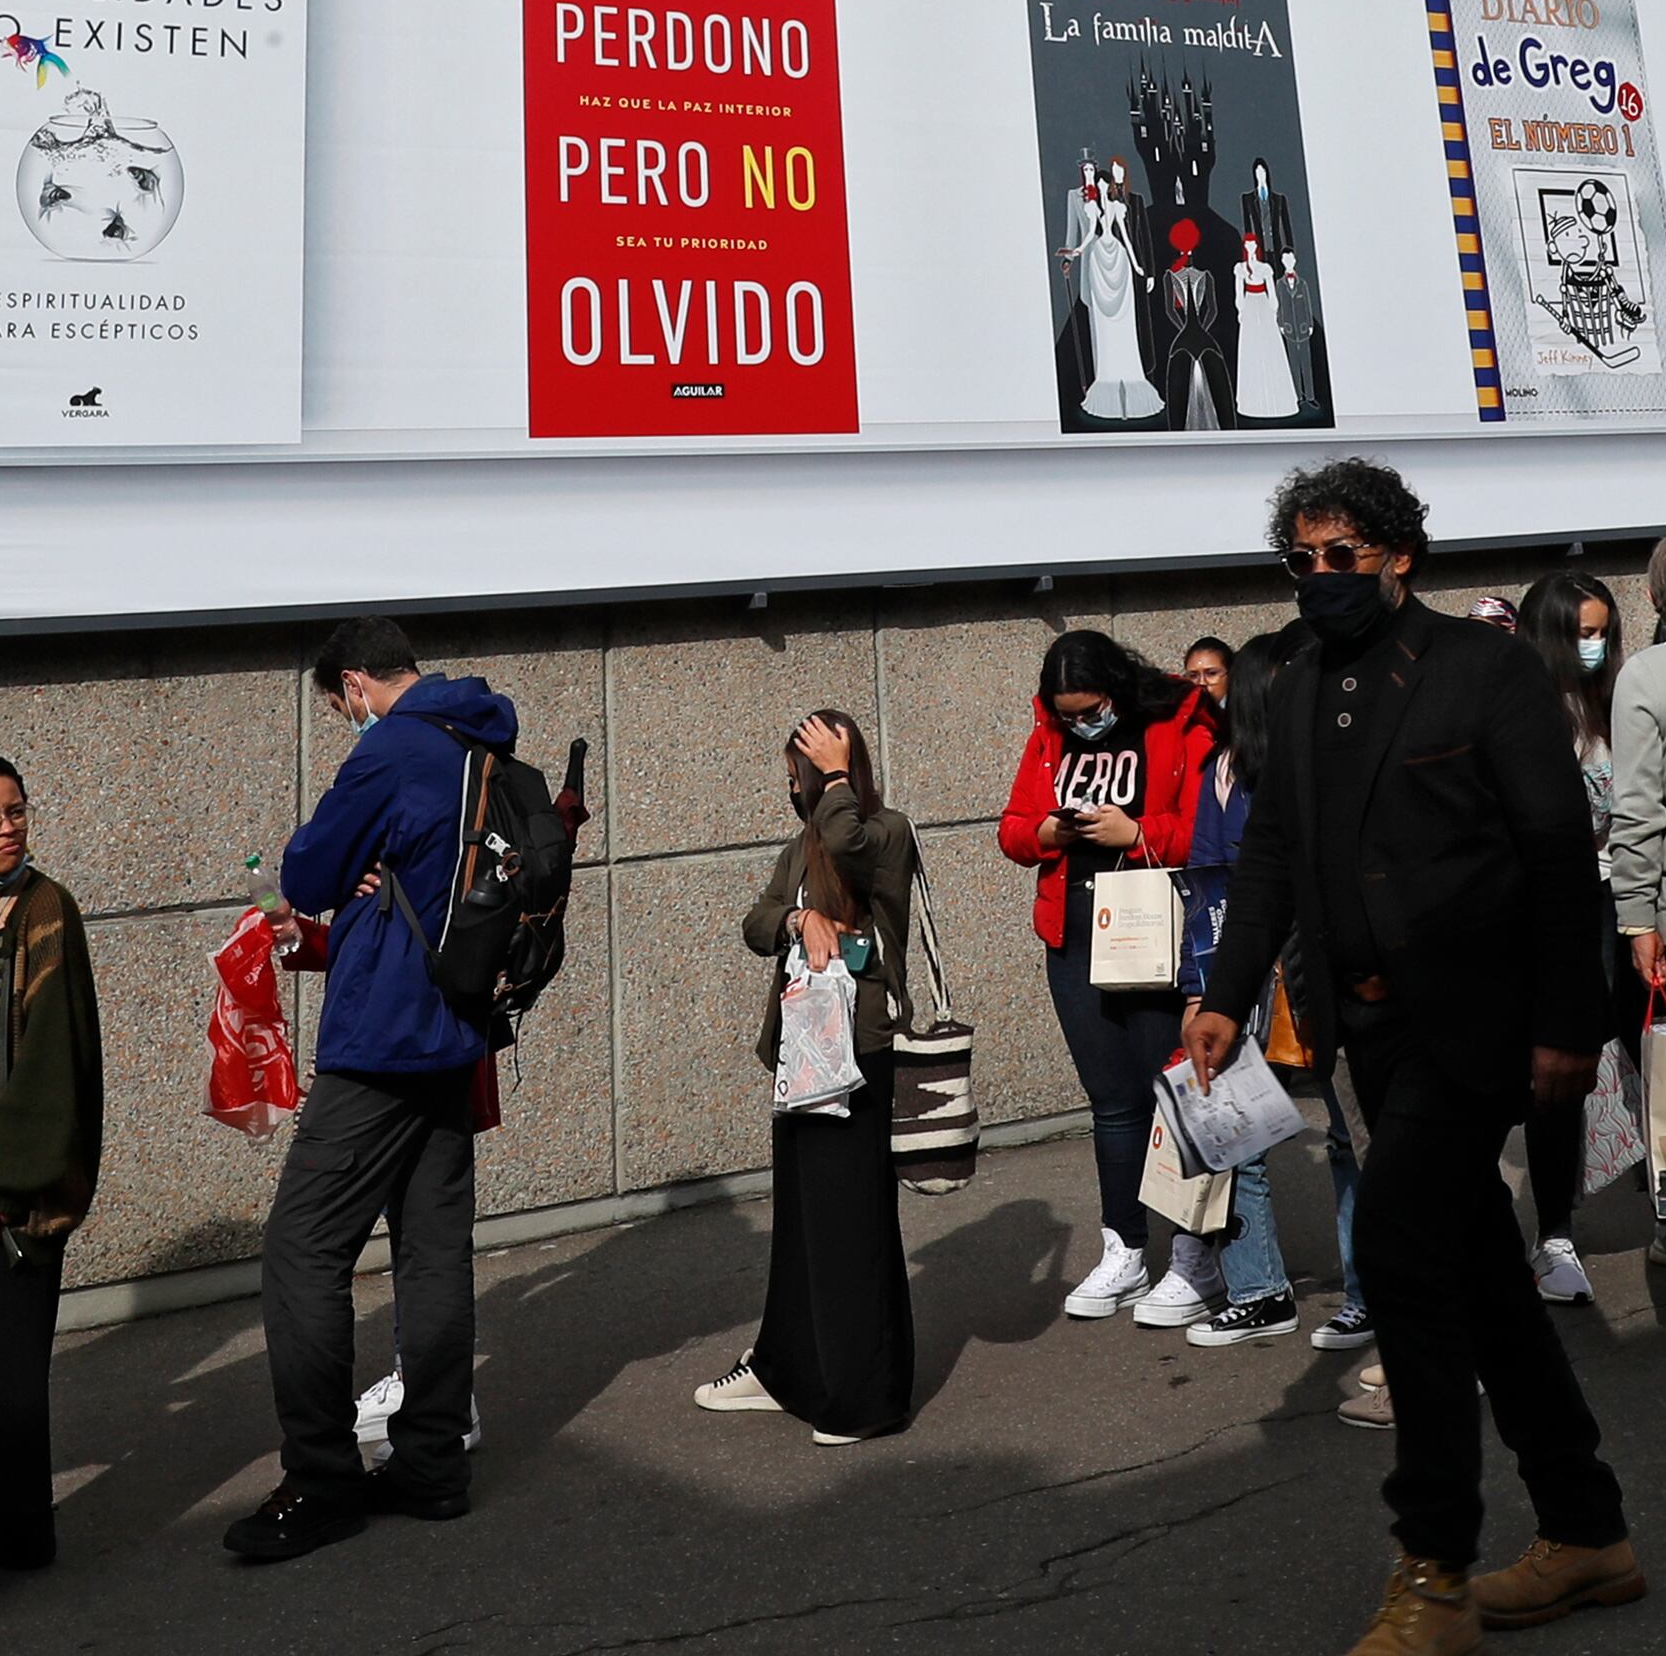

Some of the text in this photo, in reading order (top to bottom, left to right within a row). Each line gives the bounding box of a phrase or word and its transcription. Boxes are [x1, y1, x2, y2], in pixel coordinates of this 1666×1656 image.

[54, 17, 249, 60] EXISTEN
[555, 2, 811, 80] PERDONO
[1039, 1, 1173, 47] La familia
[1471, 35, 1619, 114] de Greg
[579, 95, 793, 118] HAZ QUE LA PAZ INTERIOR
[1619, 88, 1639, 118] 16
[1488, 114, 1619, 157] EL NÚMERO
[557, 134, 817, 212] PERO NO
[616, 236, 769, 252] SEA TU PRIORIDAD
[50, 317, 200, 341] ESCÉPTICOS
[560, 275, 826, 367] OLVIDO
[1537, 350, 1593, 370] Jeff Kinney
[60, 408, 110, 420] VERGARA
[1505, 388, 1538, 397] MOLINO
[1054, 750, 1138, 809] AERO
